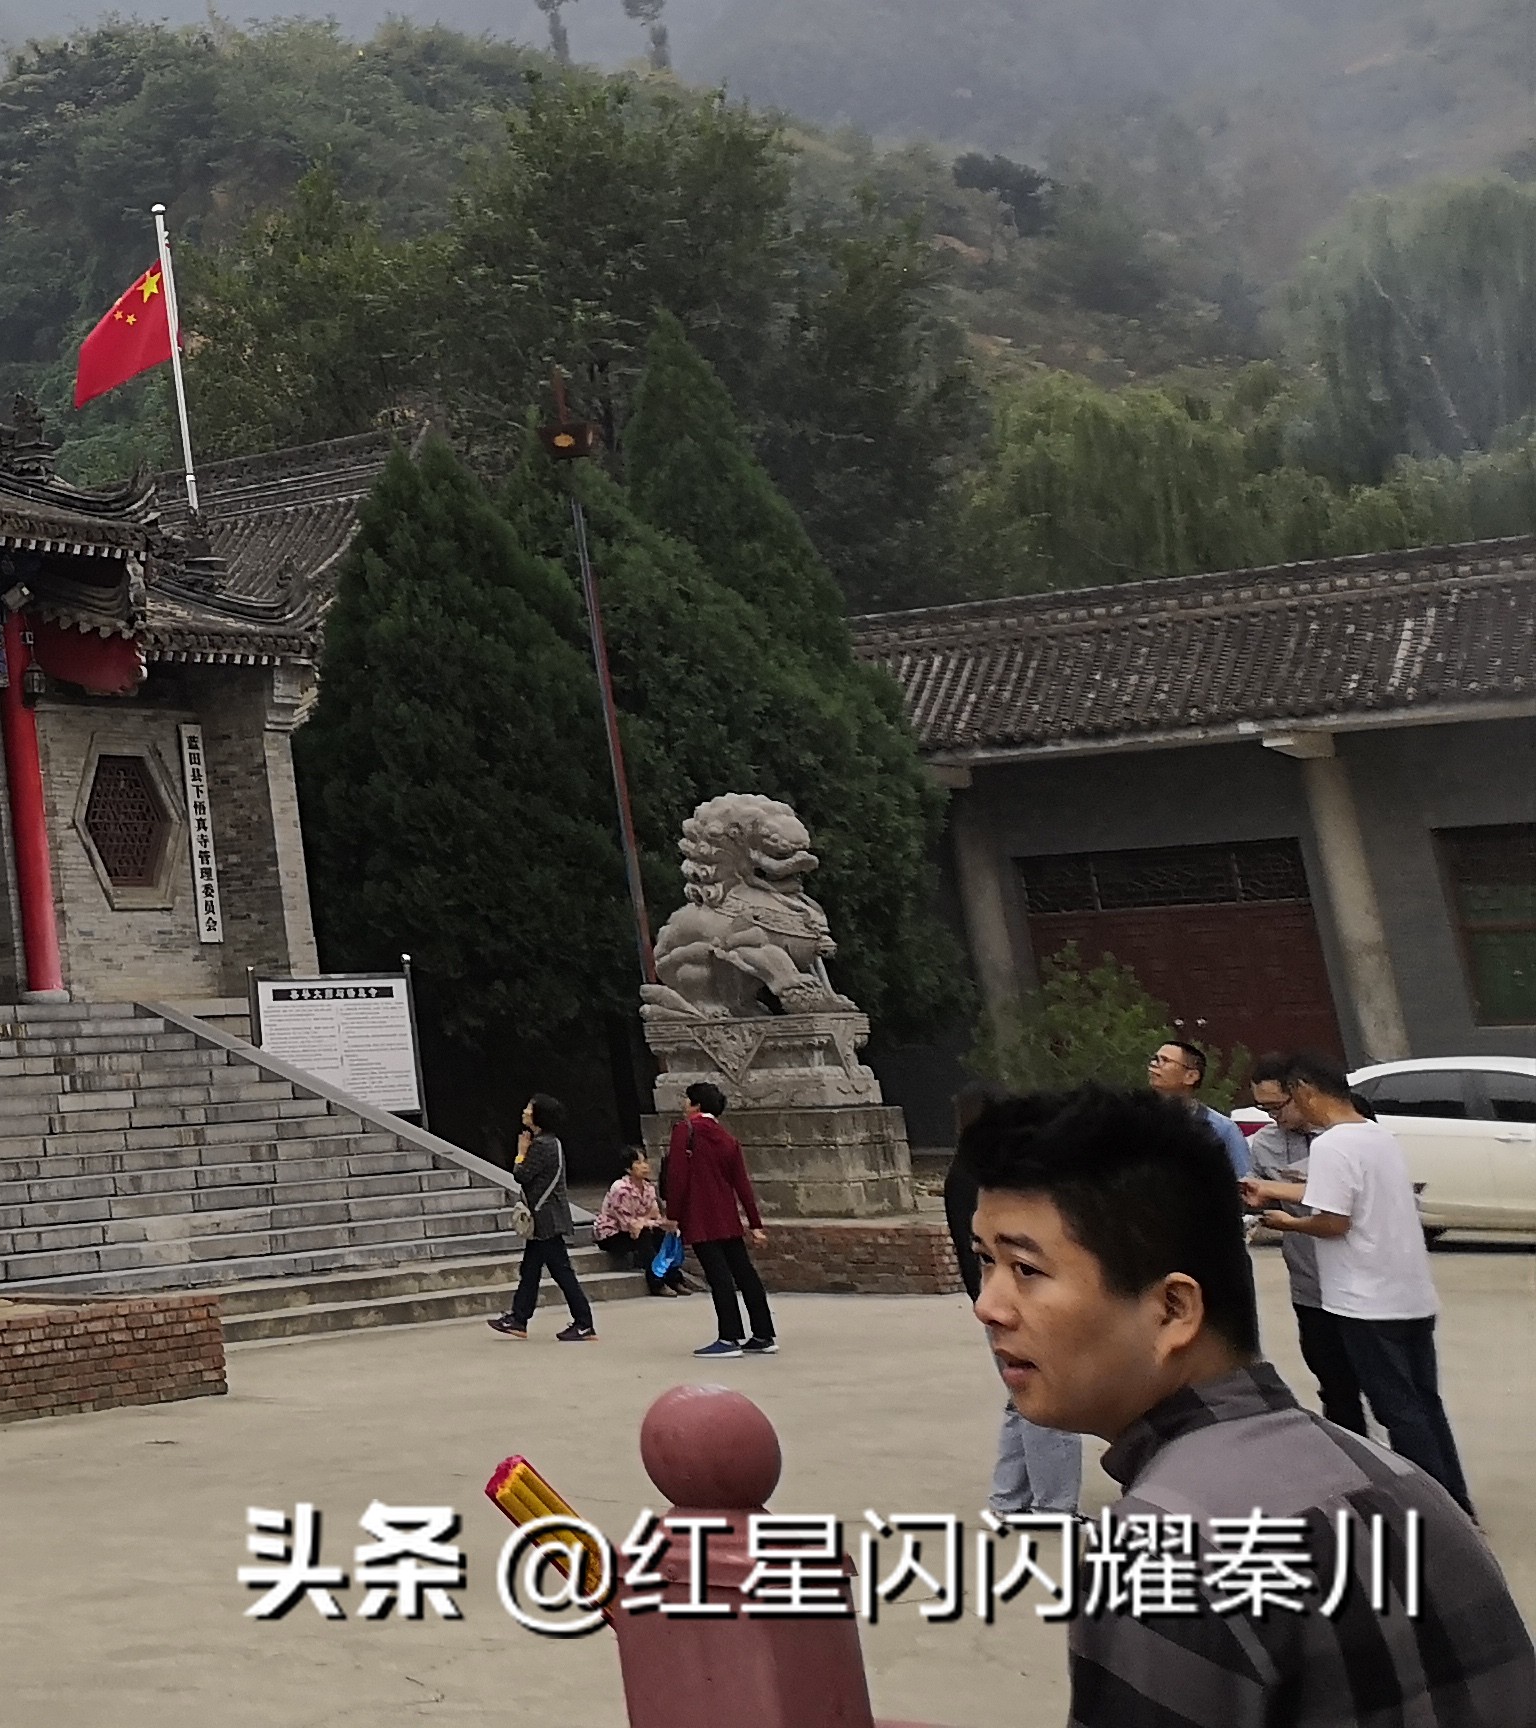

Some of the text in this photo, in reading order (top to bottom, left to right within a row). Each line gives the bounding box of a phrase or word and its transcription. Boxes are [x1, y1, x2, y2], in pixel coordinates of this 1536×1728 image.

[186, 735, 217, 932] 蓝田县下悟真寺管理委员会
